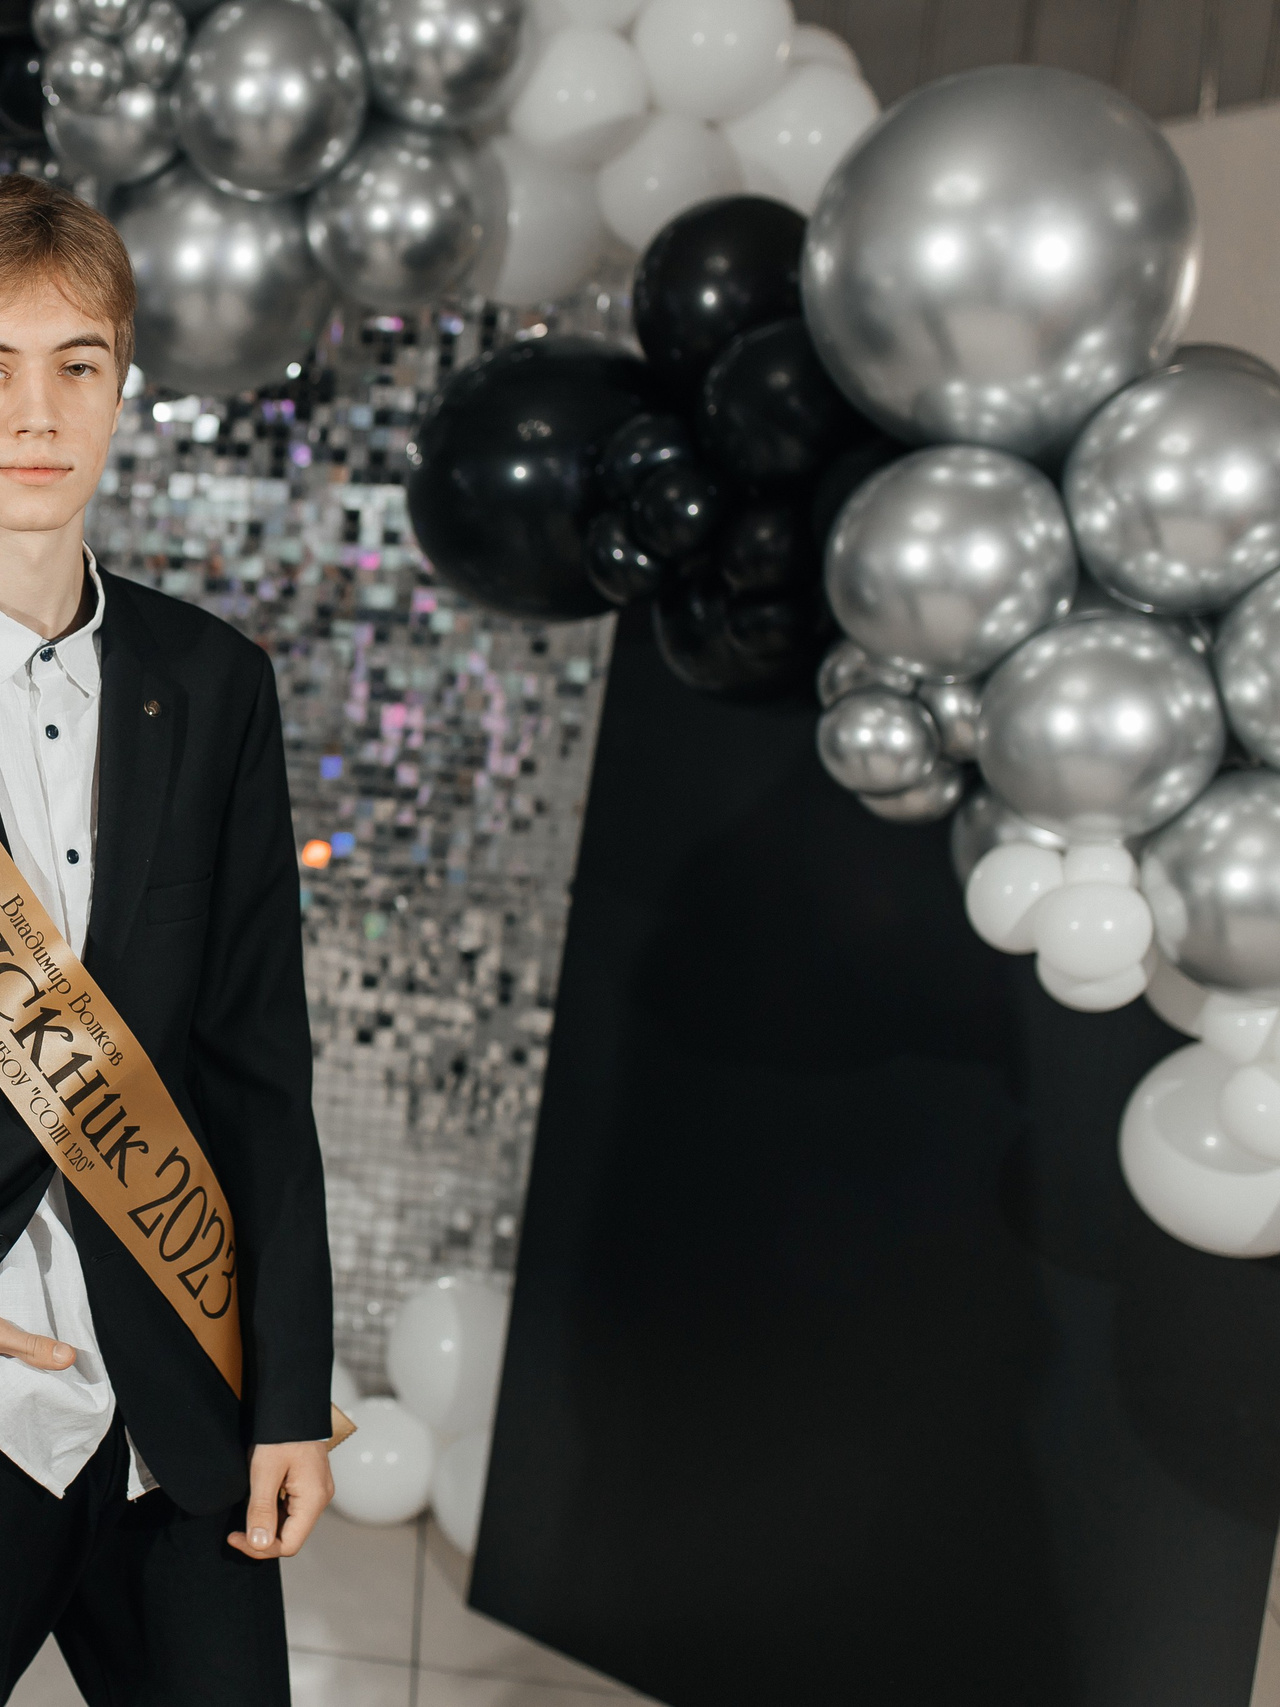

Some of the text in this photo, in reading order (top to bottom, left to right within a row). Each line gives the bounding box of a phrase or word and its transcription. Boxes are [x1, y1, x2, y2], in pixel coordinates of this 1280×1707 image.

[0, 893, 124, 1067] Владимир Волков
[127, 1146, 236, 1320] 2023
